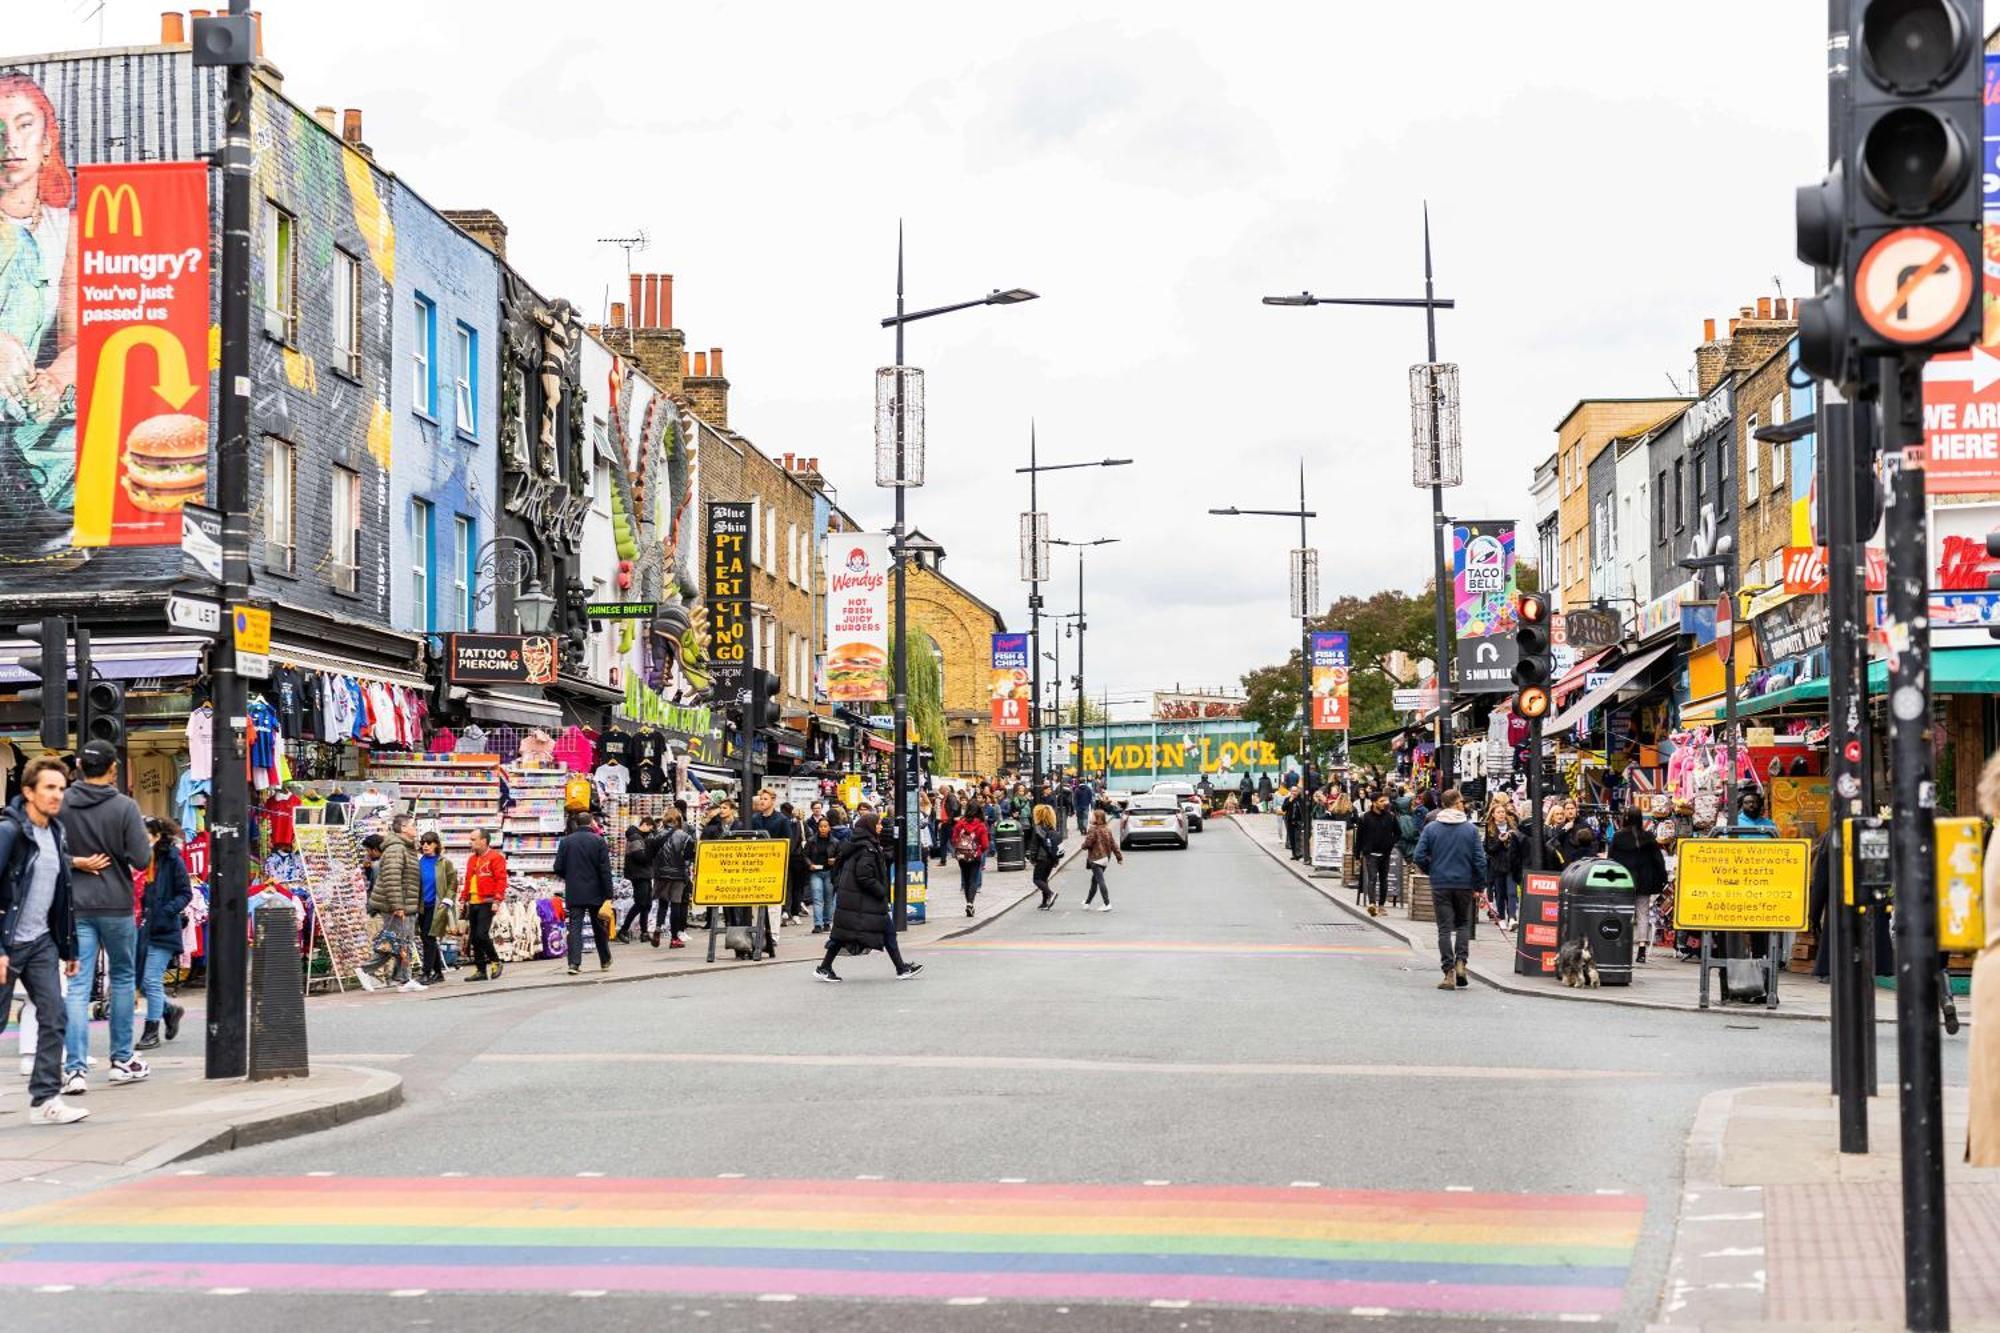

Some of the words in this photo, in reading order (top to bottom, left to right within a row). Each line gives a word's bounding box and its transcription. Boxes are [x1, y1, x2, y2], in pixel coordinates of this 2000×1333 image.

[83, 248, 202, 280] Hungry?
[82, 285, 137, 301] You've
[140, 283, 174, 304] just
[82, 305, 143, 325] passed
[146, 308, 168, 320] us
[1923, 403, 1957, 430] WE
[1962, 402, 2000, 429] AR
[1931, 433, 1998, 461] HERE
[713, 506, 746, 519] Blue
[201, 521, 221, 536] CCTV
[713, 521, 747, 534] Skin
[1468, 568, 1500, 578] TACO
[1786, 552, 1825, 588] illy
[832, 571, 883, 592] Wendy's
[1469, 579, 1498, 589] BELL
[716, 534, 731, 660] PIERCING
[730, 536, 744, 660] TATTOO
[848, 598, 867, 606] HOT
[587, 605, 621, 615] CHINESE
[623, 604, 653, 614] BUFFET
[842, 607, 873, 615] FRESH
[843, 615, 872, 623] JUICY
[835, 623, 881, 632] BURGERS
[457, 648, 507, 660] TATTOO
[510, 650, 519, 660] &
[995, 651, 1016, 660] FISH
[1017, 652, 1024, 660] &
[458, 659, 519, 671] PIERCING
[995, 660, 1025, 668] CHIPS
[1466, 671, 1473, 681] 5
[1473, 669, 1488, 681] MIN
[1489, 668, 1512, 680] WALK
[1590, 677, 1608, 686] AT
[1007, 718, 1021, 726] MIN
[1198, 737, 1280, 773] LOCK
[1698, 846, 1742, 854] Advance
[1747, 846, 1790, 856] Warning
[1689, 855, 1729, 864] Thames
[1734, 856, 1798, 865] Waterworks
[1712, 866, 1738, 875] Work
[1743, 867, 1774, 875] starts
[1717, 878, 1740, 886] here
[1744, 877, 1769, 886] from
[715, 885, 751, 893] Apologies
[1712, 890, 1721, 898] to
[1745, 890, 1762, 899] Oct
[1766, 891, 1792, 899] 2022
[1706, 902, 1757, 912] Apologies
[1762, 902, 1777, 911] for
[1692, 914, 1709, 922] any
[1714, 913, 1792, 922] inconvenience
